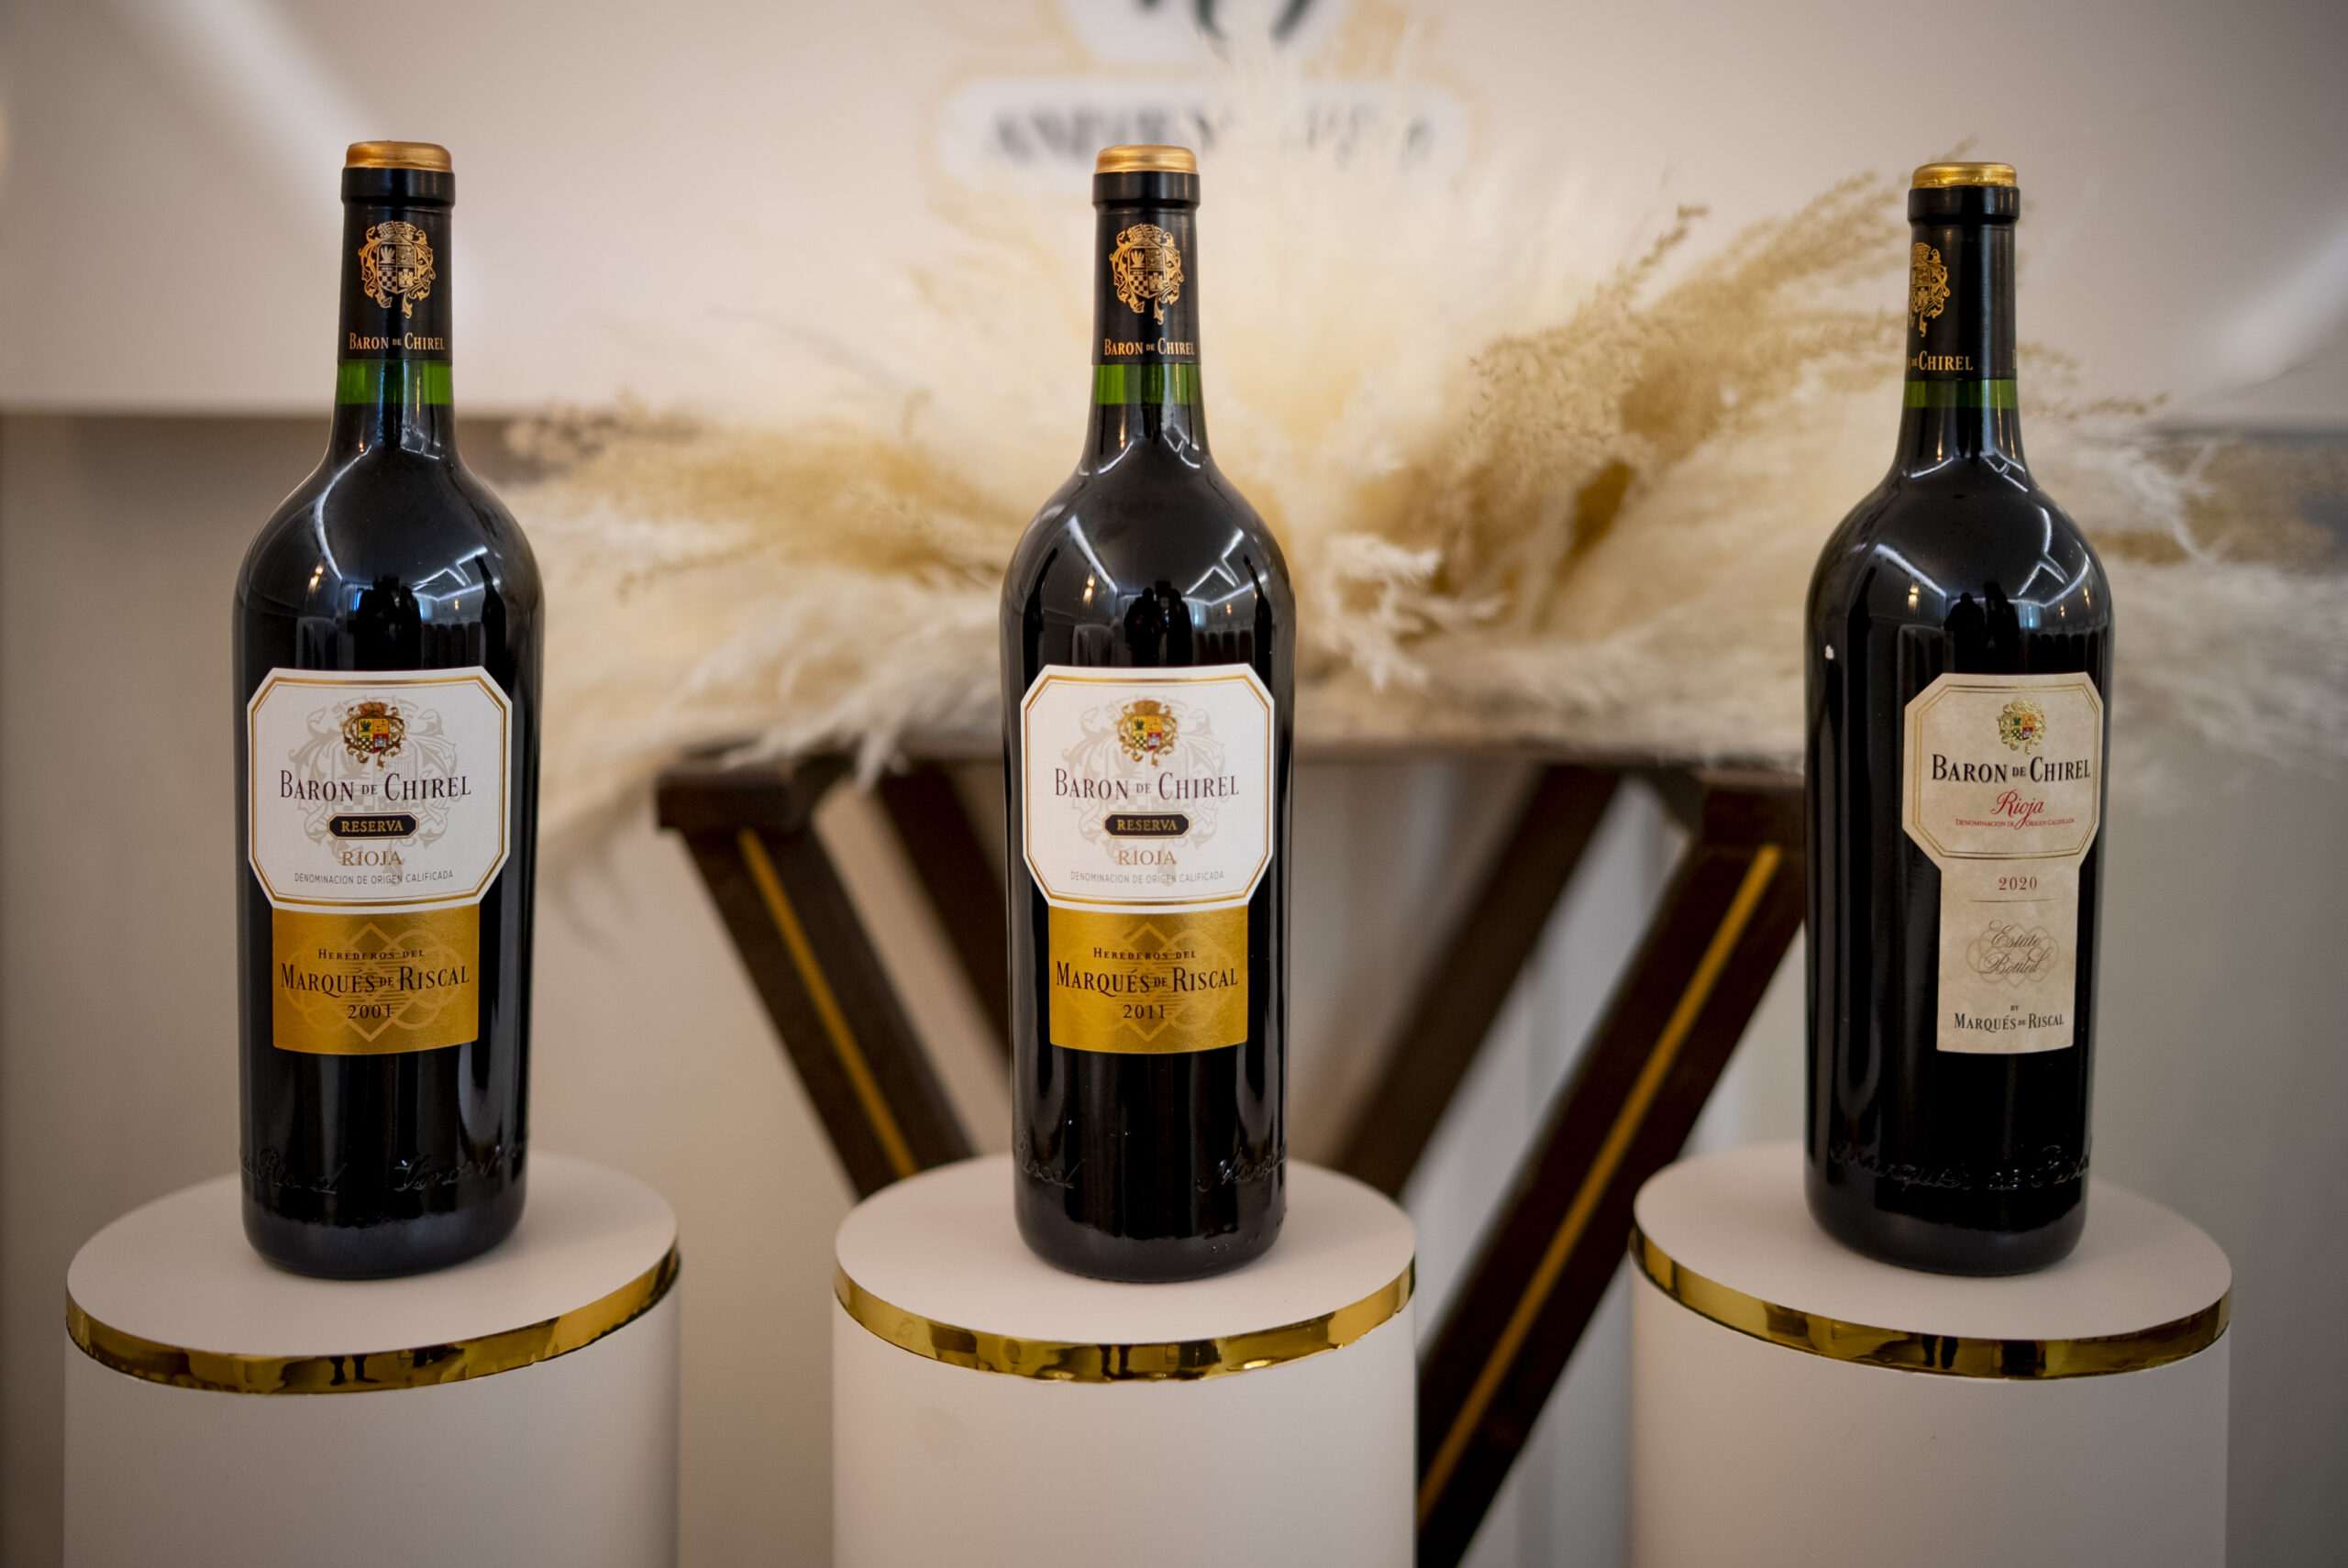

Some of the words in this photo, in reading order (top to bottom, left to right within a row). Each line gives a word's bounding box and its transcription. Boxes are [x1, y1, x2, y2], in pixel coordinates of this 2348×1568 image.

[349, 332, 389, 349] BARON
[404, 332, 445, 350] CHIREL
[1104, 337, 1144, 356] BARON
[1157, 337, 1195, 356] CHIREL
[1919, 350, 1974, 371] CHIREL
[1932, 754, 2008, 783] BARON
[2011, 767, 2026, 778] DE
[2030, 756, 2091, 782] CHIREL
[280, 769, 354, 801] BARON
[361, 784, 378, 795] DE
[384, 772, 471, 801] CHIREL
[1055, 767, 1128, 801] BARON
[1135, 783, 1151, 794] DE
[1158, 771, 1239, 801] CHIREL
[1990, 789, 2044, 830] Rioja
[341, 820, 404, 833] RESERVA
[1116, 819, 1178, 832] RESERVA
[341, 850, 404, 867] RIOJA
[1118, 849, 1178, 866] RIOJA
[294, 872, 354, 885] DENOMINACION
[357, 875, 368, 885] DE
[371, 873, 403, 885] ORIGEN
[405, 870, 453, 883] CALIFICADA
[1070, 870, 1129, 884] DENOMINACION
[1132, 874, 1144, 884] DE
[1146, 872, 1176, 884] ORIGEN
[1180, 870, 1224, 883] CALIFICADA
[1999, 876, 2038, 890] 2020
[1988, 920, 2042, 948] Estate
[318, 948, 394, 960] HEREDEROS
[403, 949, 425, 958] DEL
[1093, 947, 1168, 960] HEREDEROS
[1176, 950, 1196, 959] DEL
[1978, 946, 2054, 975] Bottled
[282, 963, 375, 998] MARQUÉS
[380, 977, 393, 987] DE
[399, 966, 470, 990] RISCAL
[1057, 961, 1150, 998] MARQUÉS
[1154, 977, 1168, 987] DE
[1172, 966, 1238, 992] RISCAL
[348, 1004, 393, 1019] 2001
[1123, 1004, 1165, 1019] 2011
[1954, 1012, 2017, 1032] MARQUÉS
[2028, 1012, 2065, 1029] RISCAL
